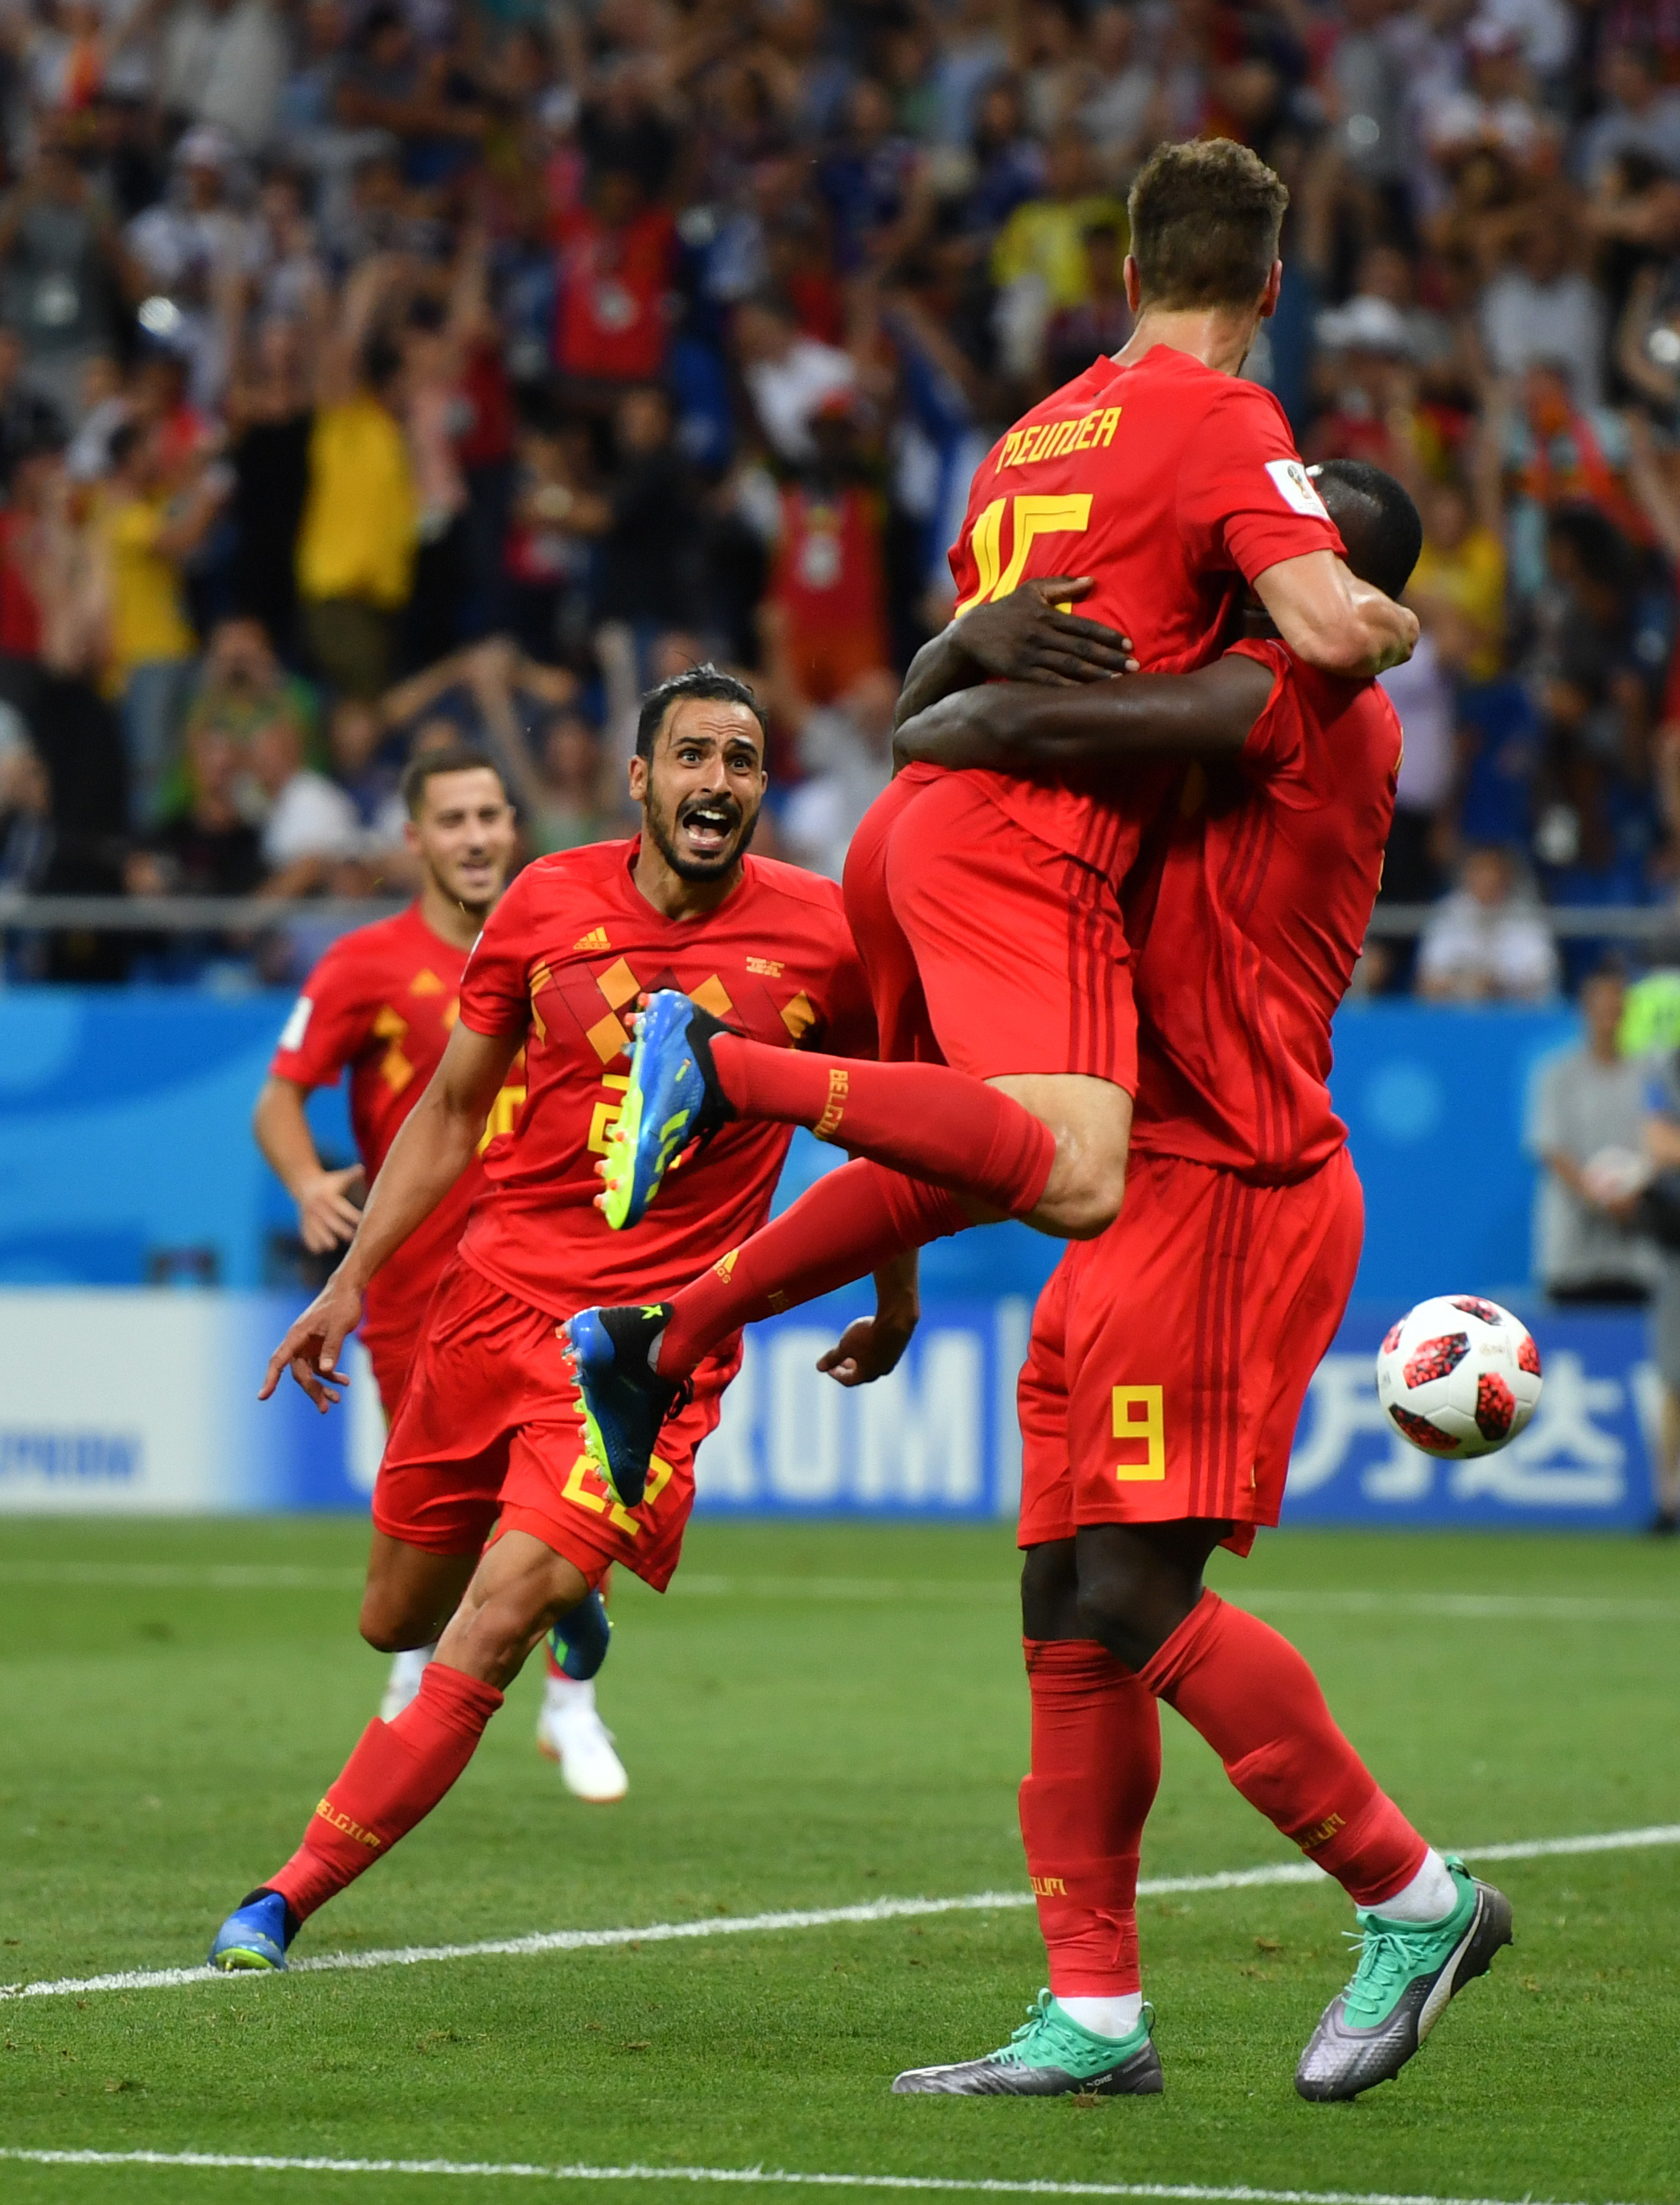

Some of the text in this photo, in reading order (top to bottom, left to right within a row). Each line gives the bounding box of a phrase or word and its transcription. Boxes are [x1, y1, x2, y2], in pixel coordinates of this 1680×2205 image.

[994, 406, 1122, 474] MEUNIER
[1112, 1385, 1164, 1480] 9
[316, 1798, 381, 1848] BELGIUM
